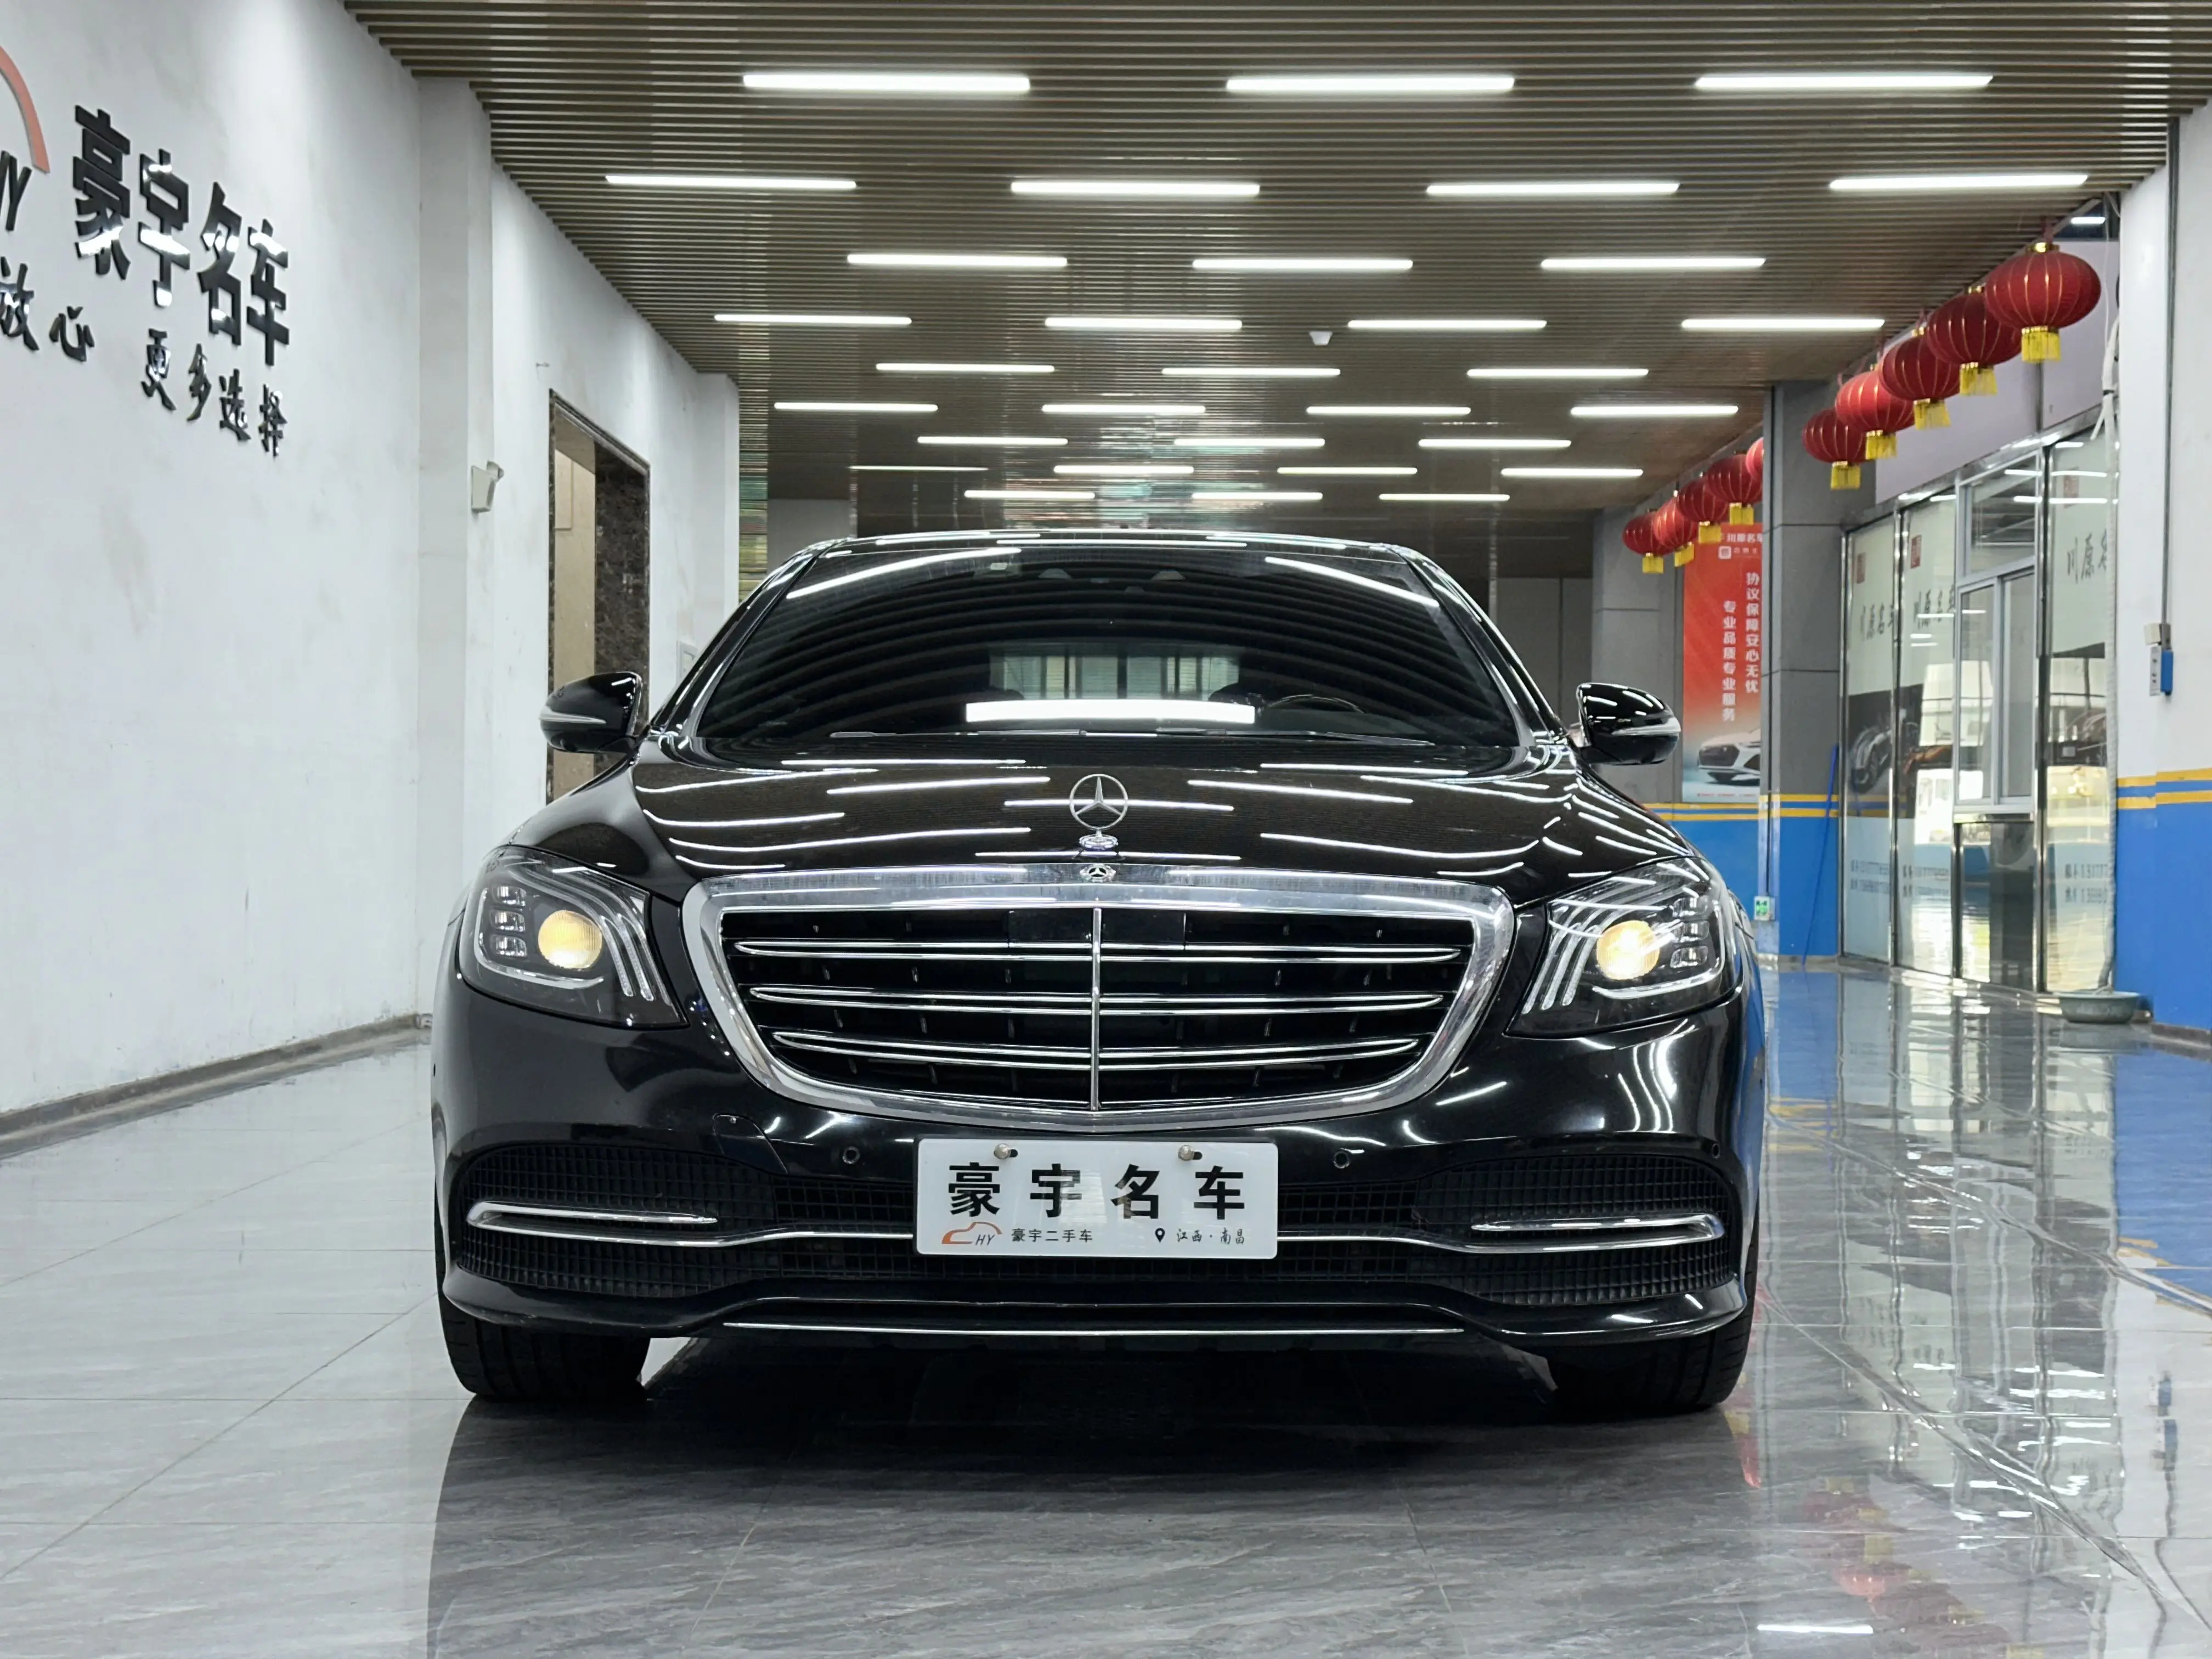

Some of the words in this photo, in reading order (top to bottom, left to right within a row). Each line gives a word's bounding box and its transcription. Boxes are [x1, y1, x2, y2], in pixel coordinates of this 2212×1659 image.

[74, 104, 289, 366] 豪宇名车
[140, 328, 287, 458] 更多选择
[1745, 572, 1760, 693] 协议保障安心无忧
[948, 1162, 1245, 1220] 豪宇名车
[1011, 1228, 1093, 1243] 豪宇二手车
[975, 1234, 995, 1246] HY
